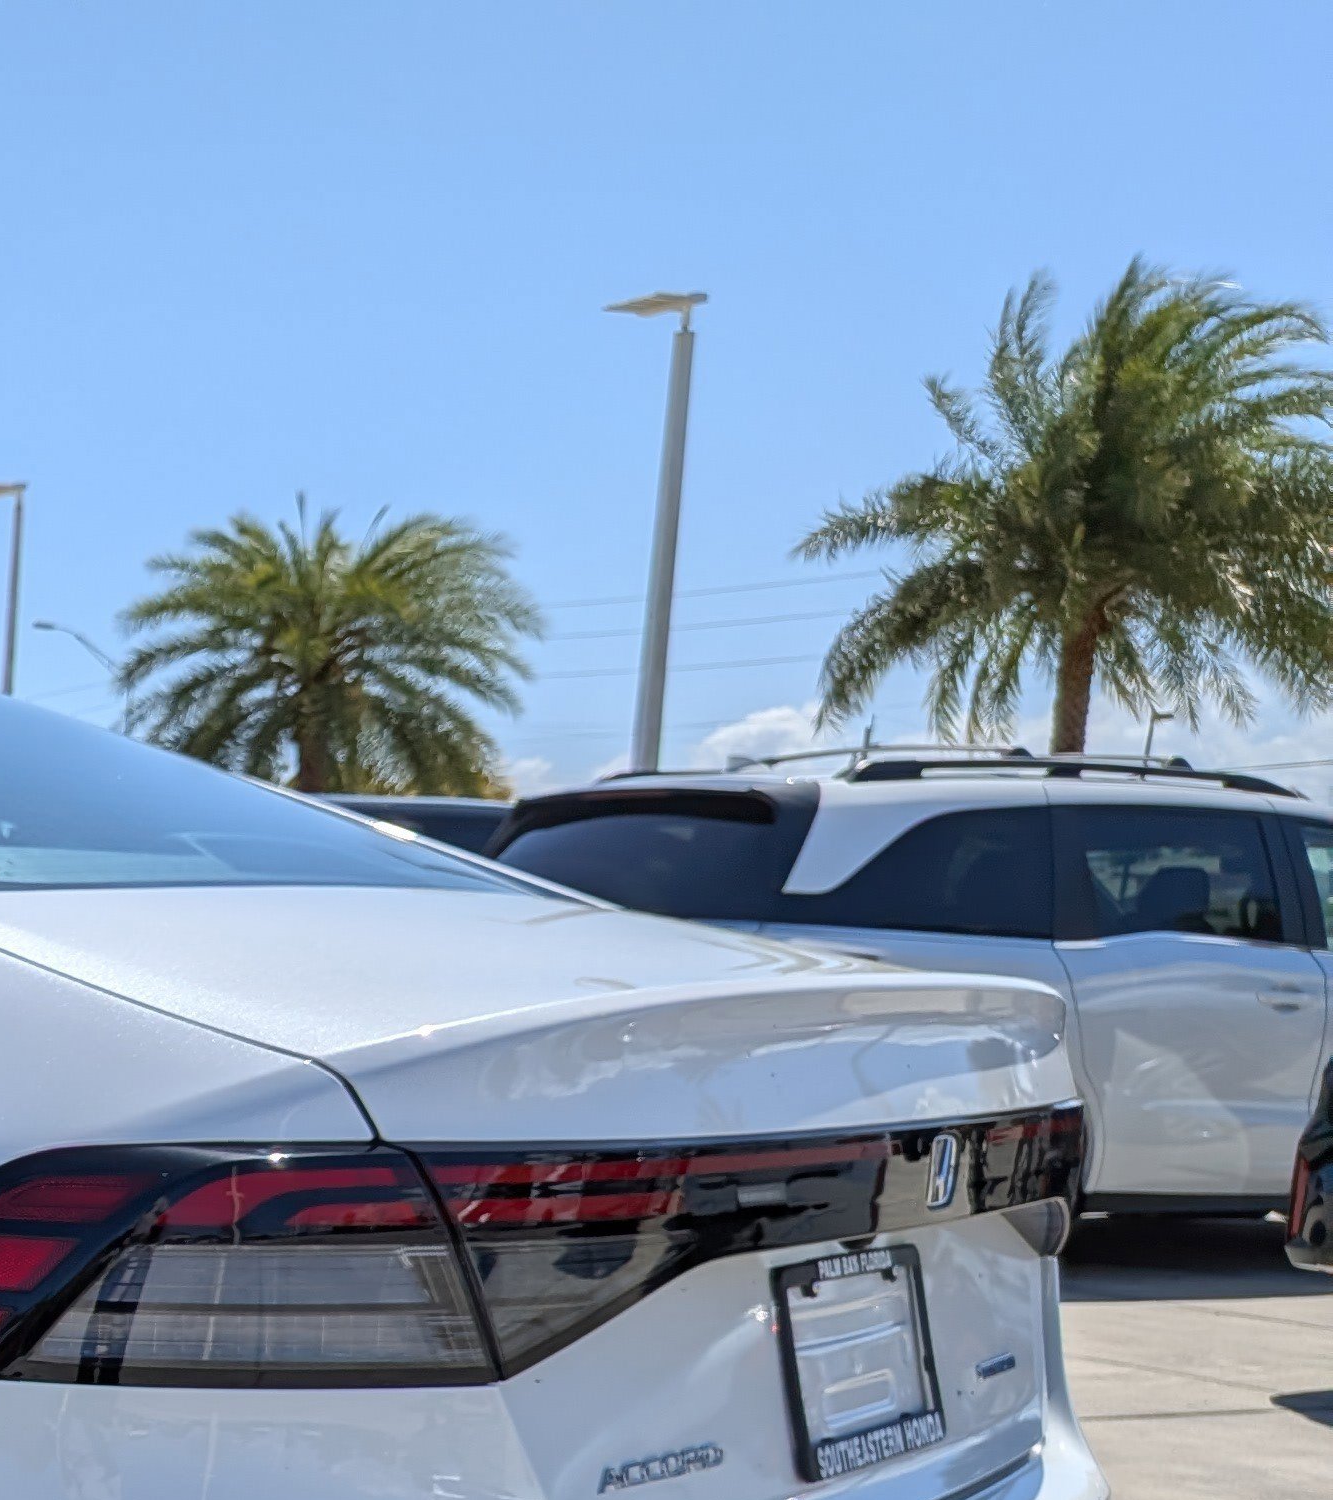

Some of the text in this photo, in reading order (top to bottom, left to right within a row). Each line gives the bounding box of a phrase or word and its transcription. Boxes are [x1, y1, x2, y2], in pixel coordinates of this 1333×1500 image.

[817, 1257, 842, 1280] PALM
[597, 1442, 724, 1495] ACCORD
[817, 1410, 944, 1479] SOUTHEASTERN HONDA
